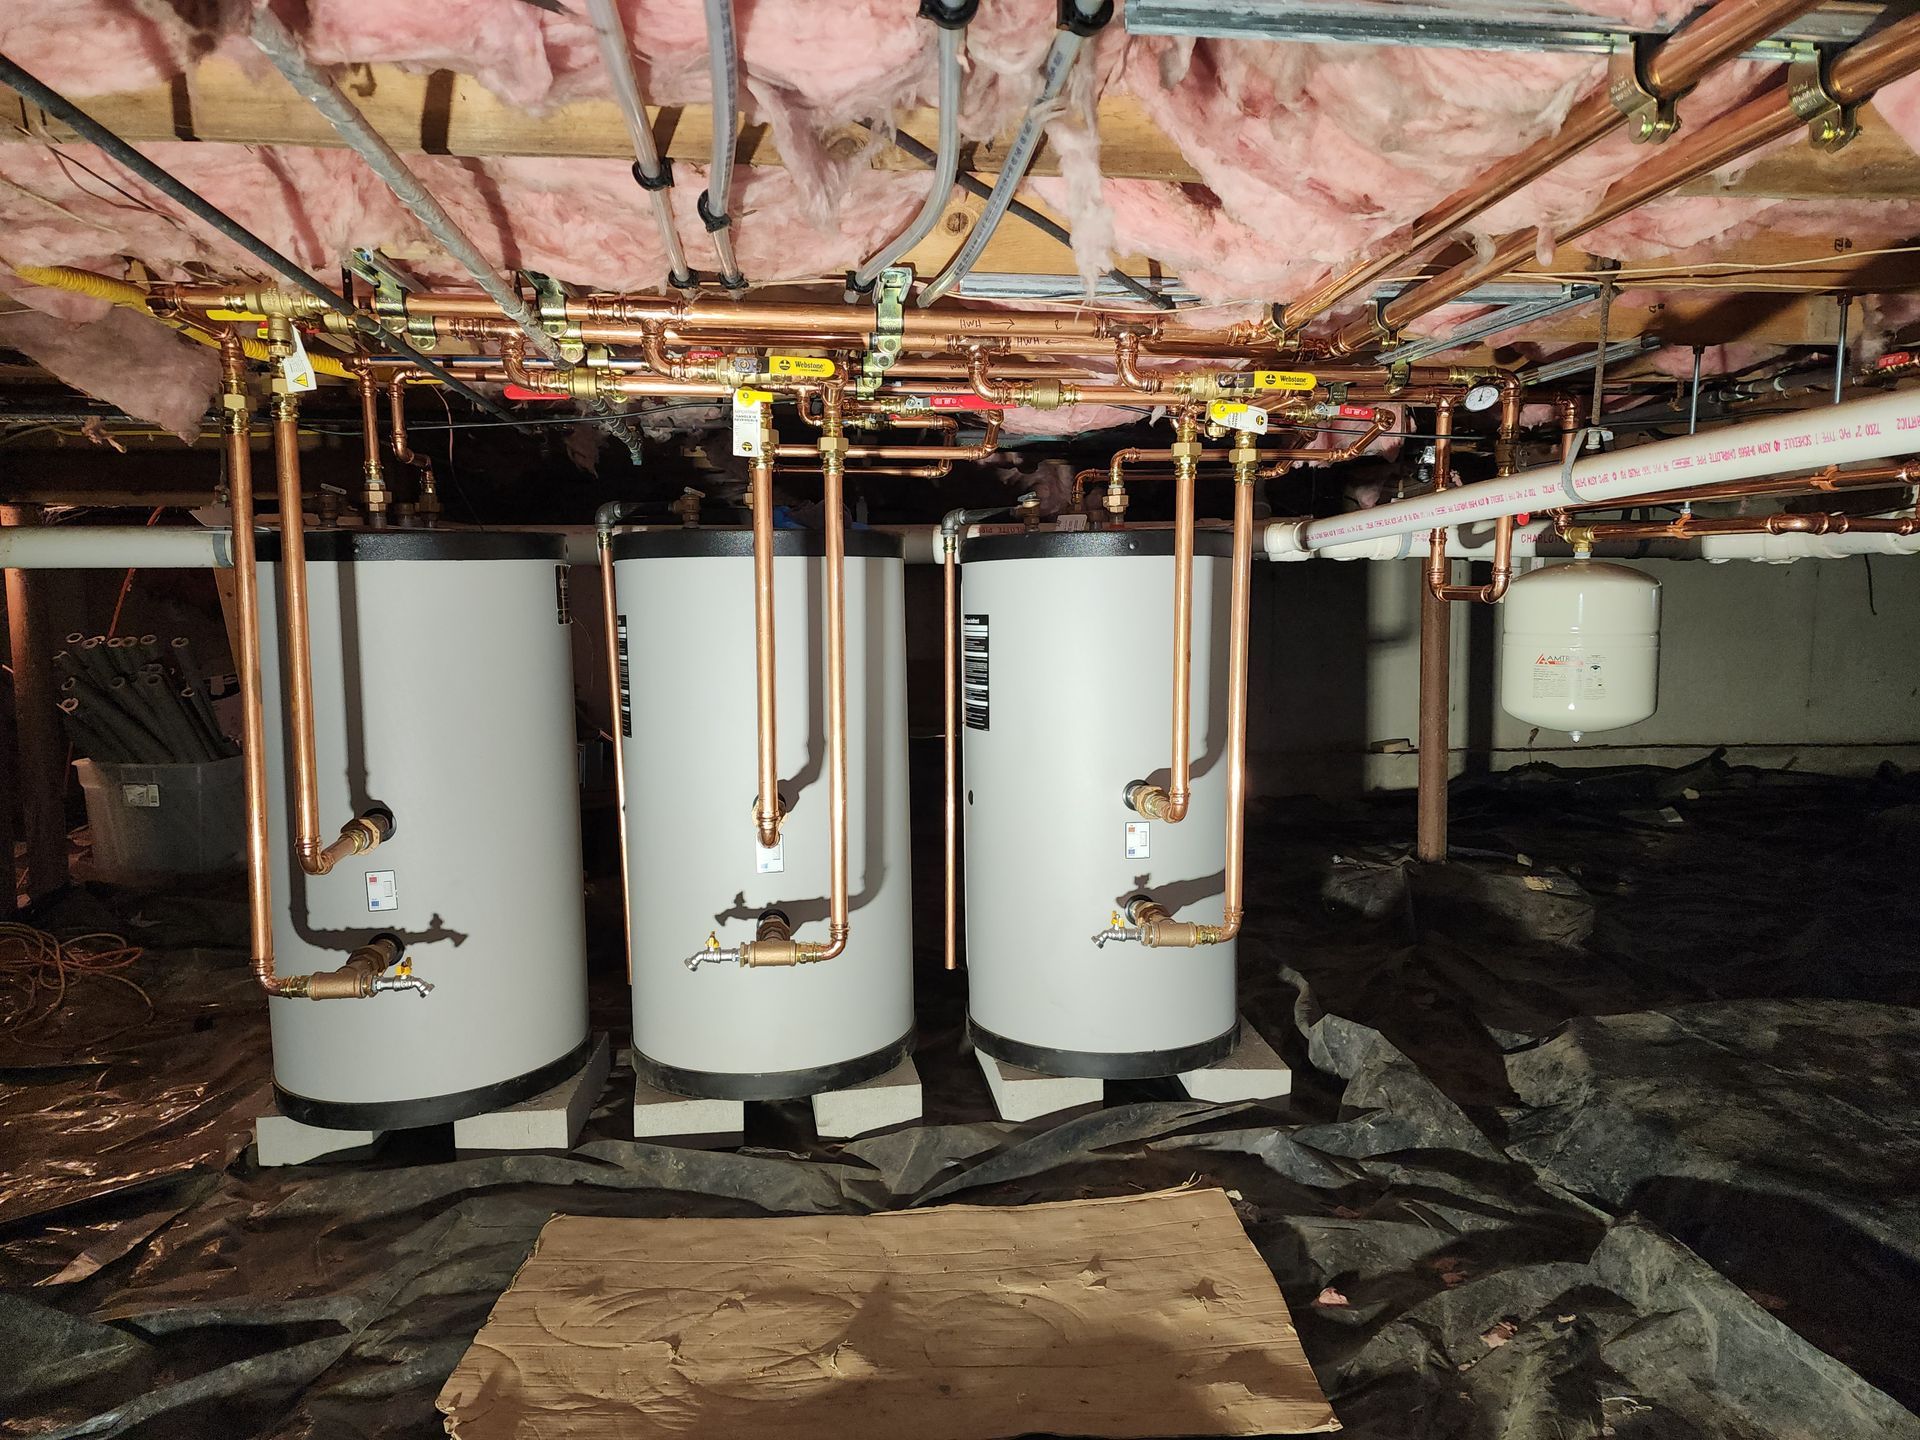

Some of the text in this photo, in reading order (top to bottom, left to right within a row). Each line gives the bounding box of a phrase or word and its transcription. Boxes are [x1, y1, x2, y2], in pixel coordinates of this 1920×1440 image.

[959, 318, 983, 329] HWH
[1016, 336, 1041, 347] HWH
[794, 360, 824, 369] Webstone
[1280, 375, 1306, 383] Webstone
[1784, 434, 1812, 450] SCHEDULE
[1708, 449, 1737, 463] CHARLOTTE
